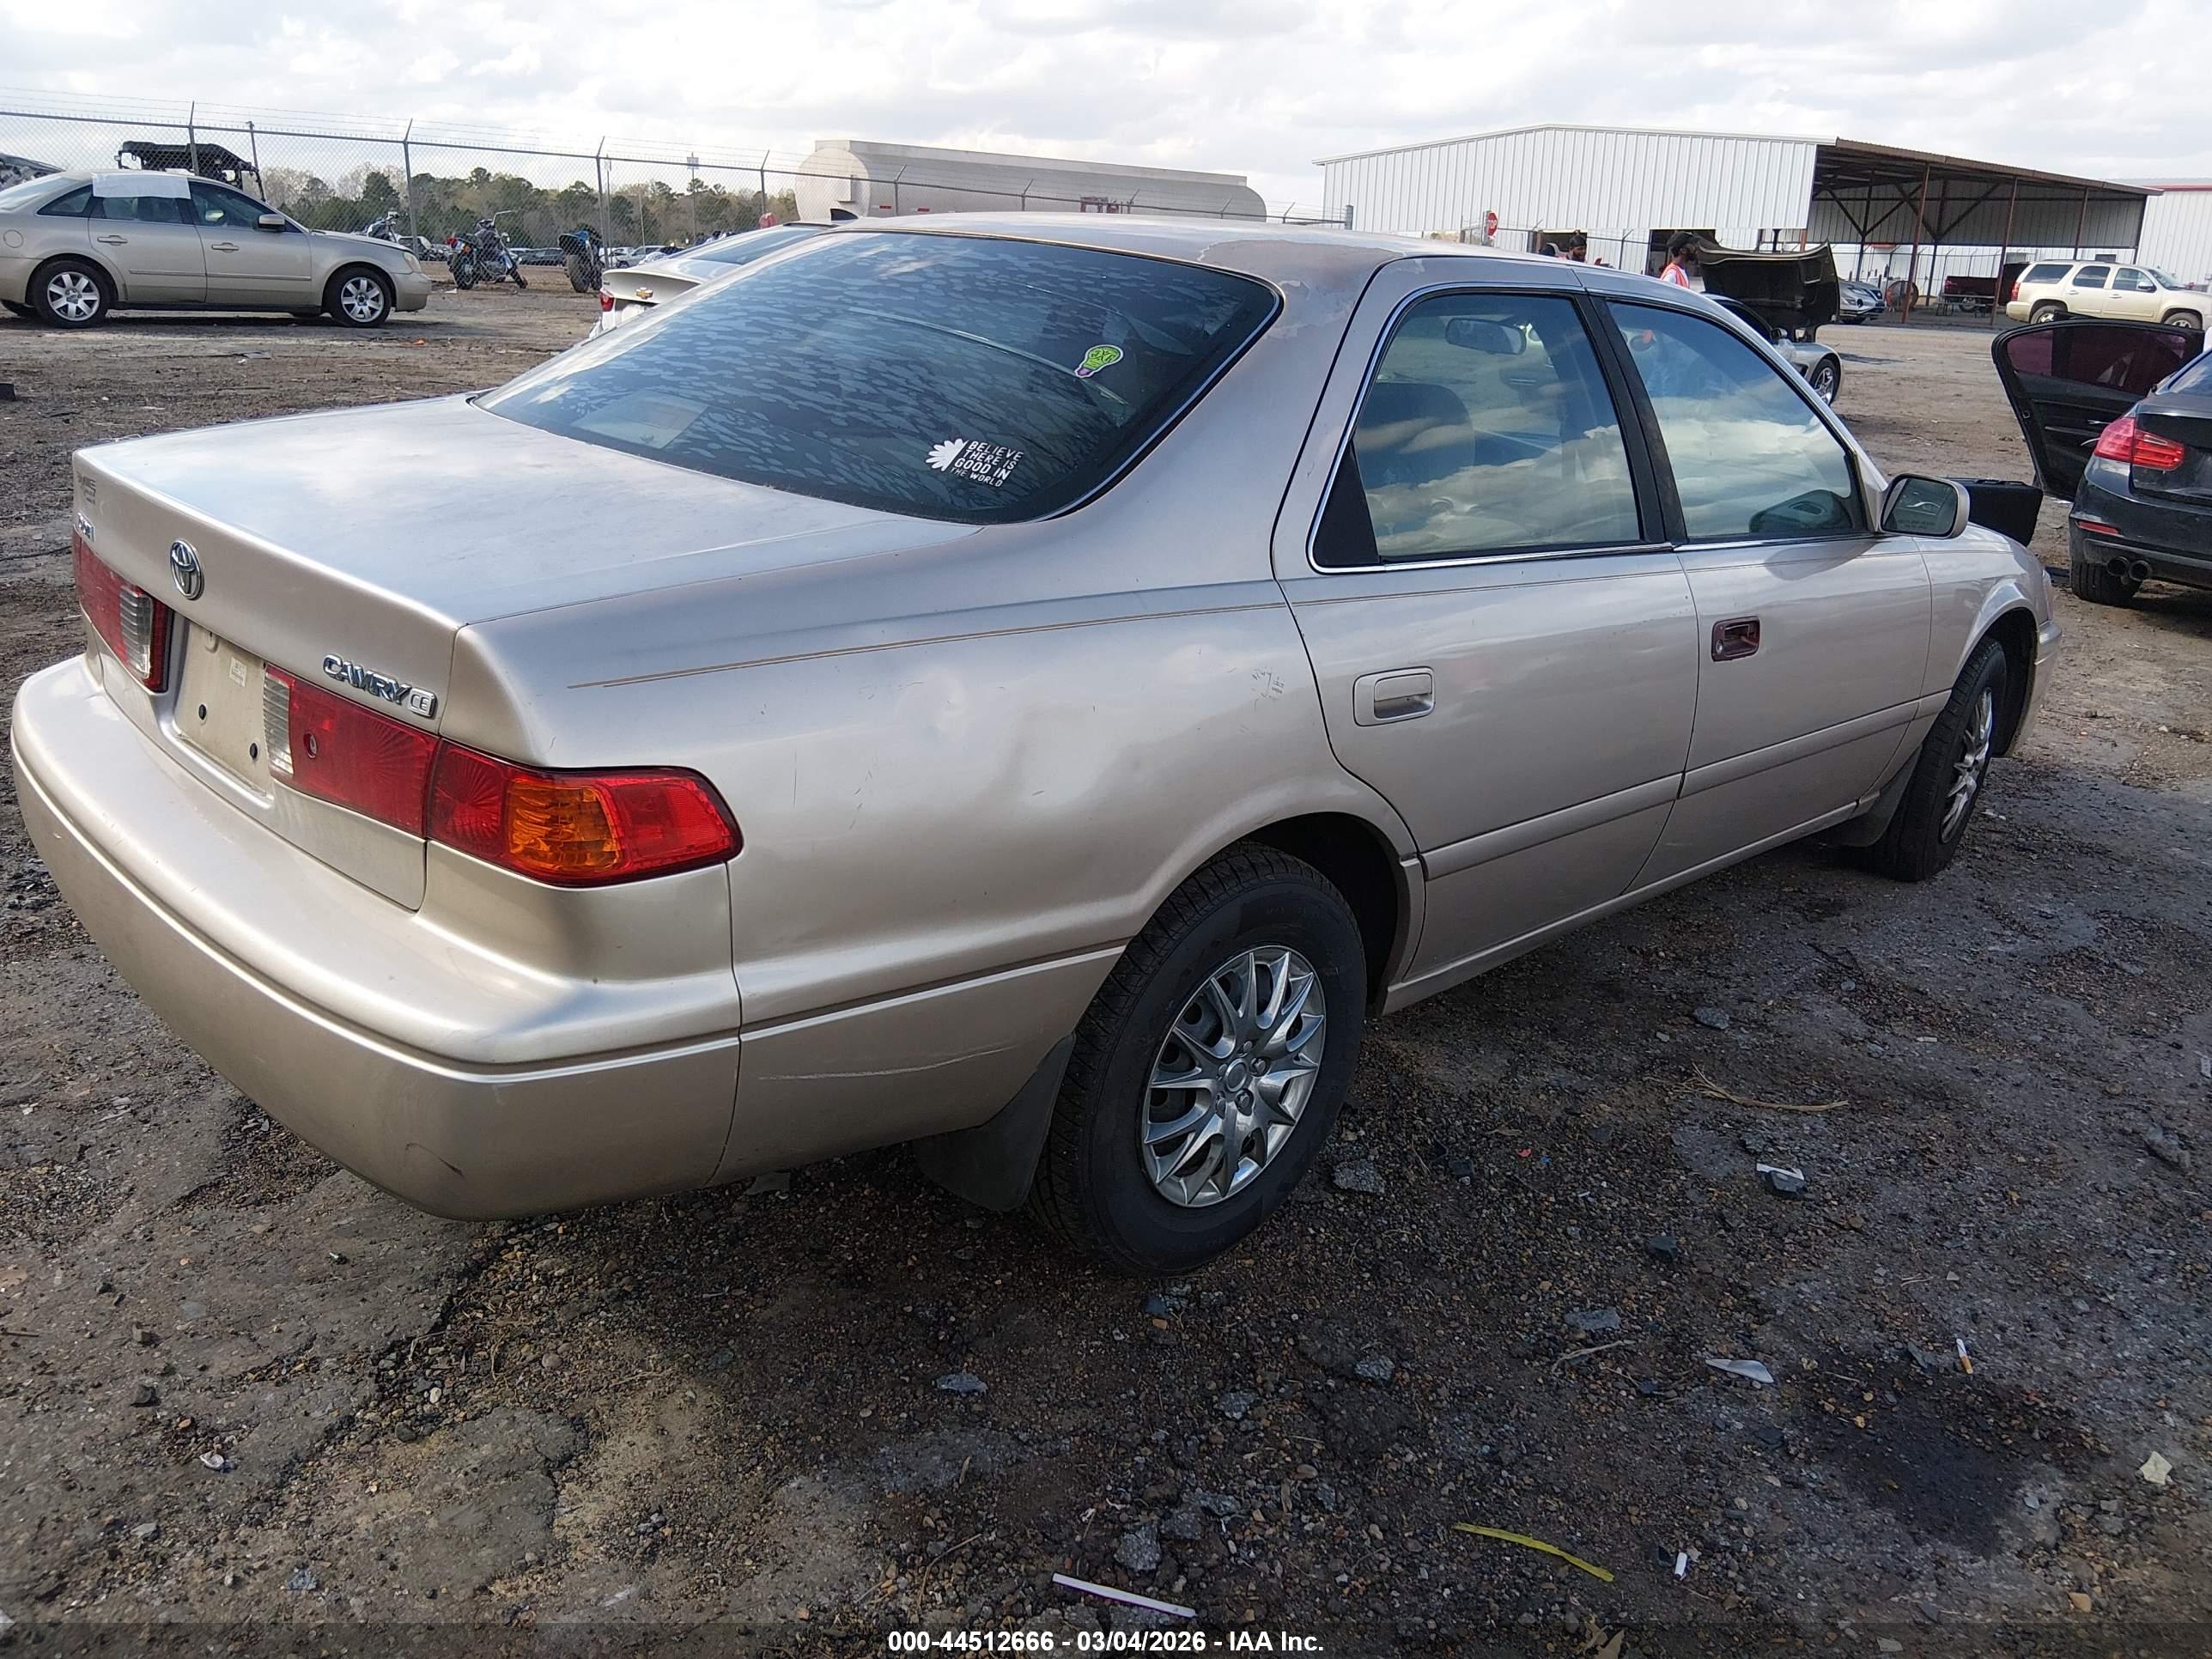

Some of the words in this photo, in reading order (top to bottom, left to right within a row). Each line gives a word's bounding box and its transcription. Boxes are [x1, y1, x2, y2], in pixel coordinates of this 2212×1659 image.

[963, 449, 1003, 465] THERE
[1002, 459, 1017, 470] IS
[968, 441, 1024, 461] BELIEVE
[950, 466, 969, 477] THE
[969, 471, 1003, 487] WORLD
[954, 458, 992, 474] GOOD
[993, 466, 1012, 480] IN
[323, 653, 413, 706] CAMRY
